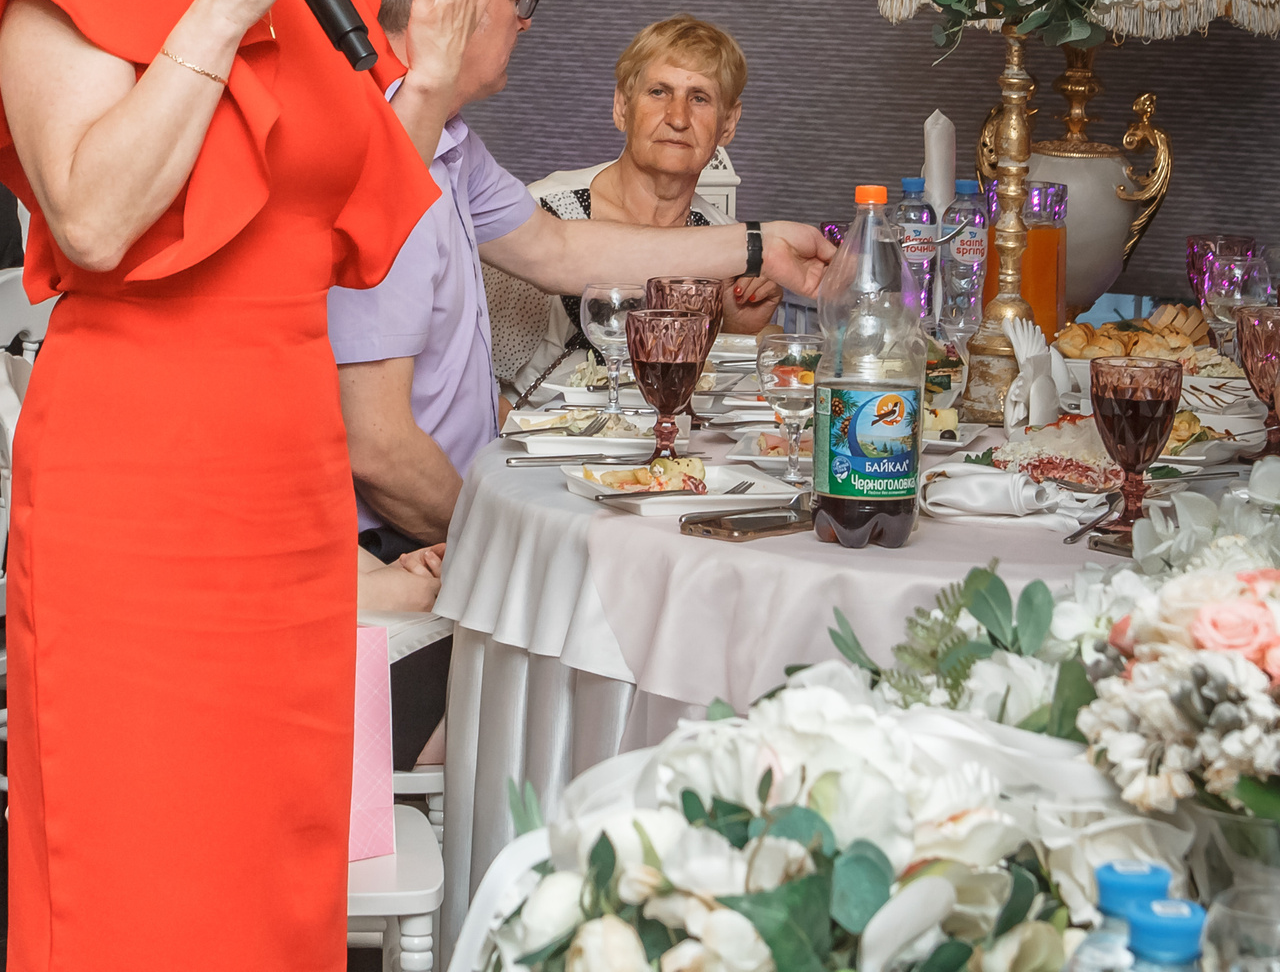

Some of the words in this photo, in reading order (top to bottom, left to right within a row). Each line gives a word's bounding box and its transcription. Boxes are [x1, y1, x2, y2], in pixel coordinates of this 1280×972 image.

[960, 238, 984, 247] saint
[956, 247, 985, 257] spring
[865, 459, 908, 473] БАЙКАЛ
[851, 474, 915, 494] Черноголовка
